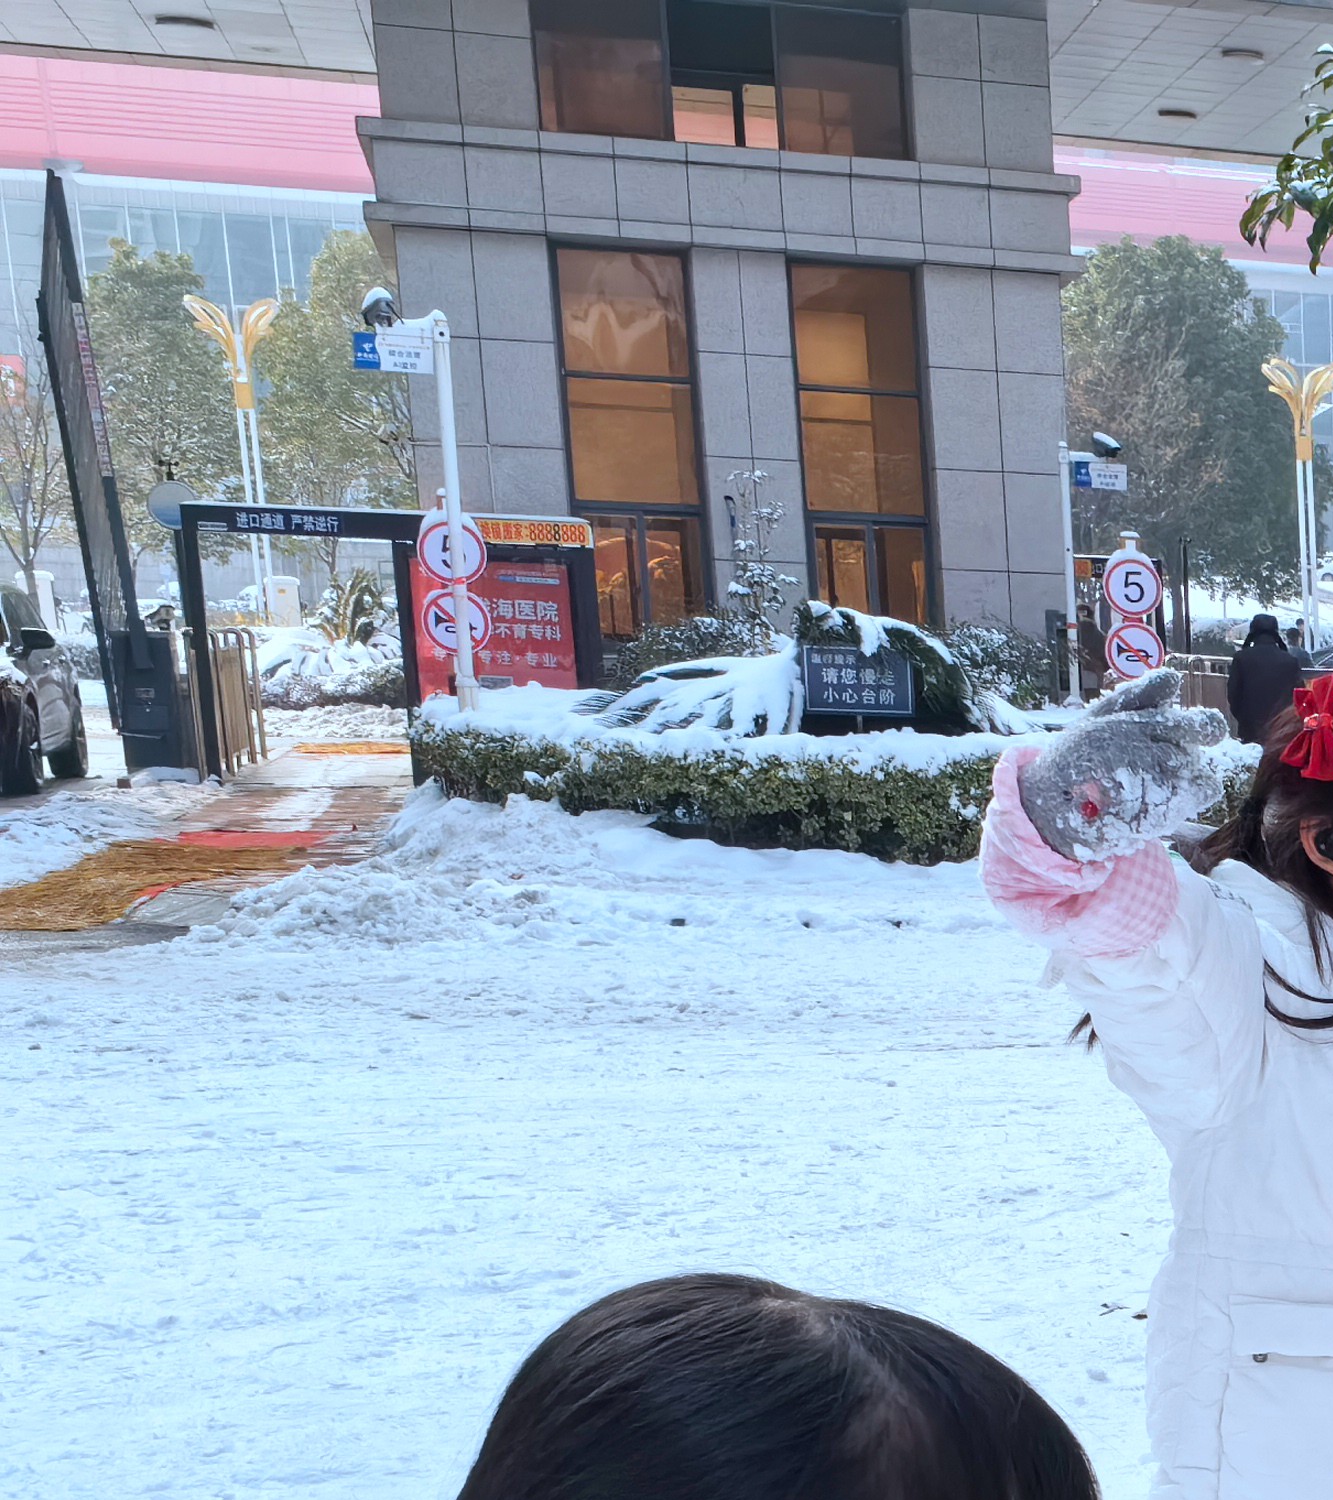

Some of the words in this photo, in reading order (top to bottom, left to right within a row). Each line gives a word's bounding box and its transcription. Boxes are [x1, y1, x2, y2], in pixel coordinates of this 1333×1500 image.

[236, 512, 285, 530] 进口通道
[290, 514, 339, 533] 严禁逆行
[1123, 571, 1145, 603] 5
[490, 622, 561, 642] 不育专科
[821, 667, 896, 686] 请您慢走
[823, 686, 896, 705] 小心台阶
